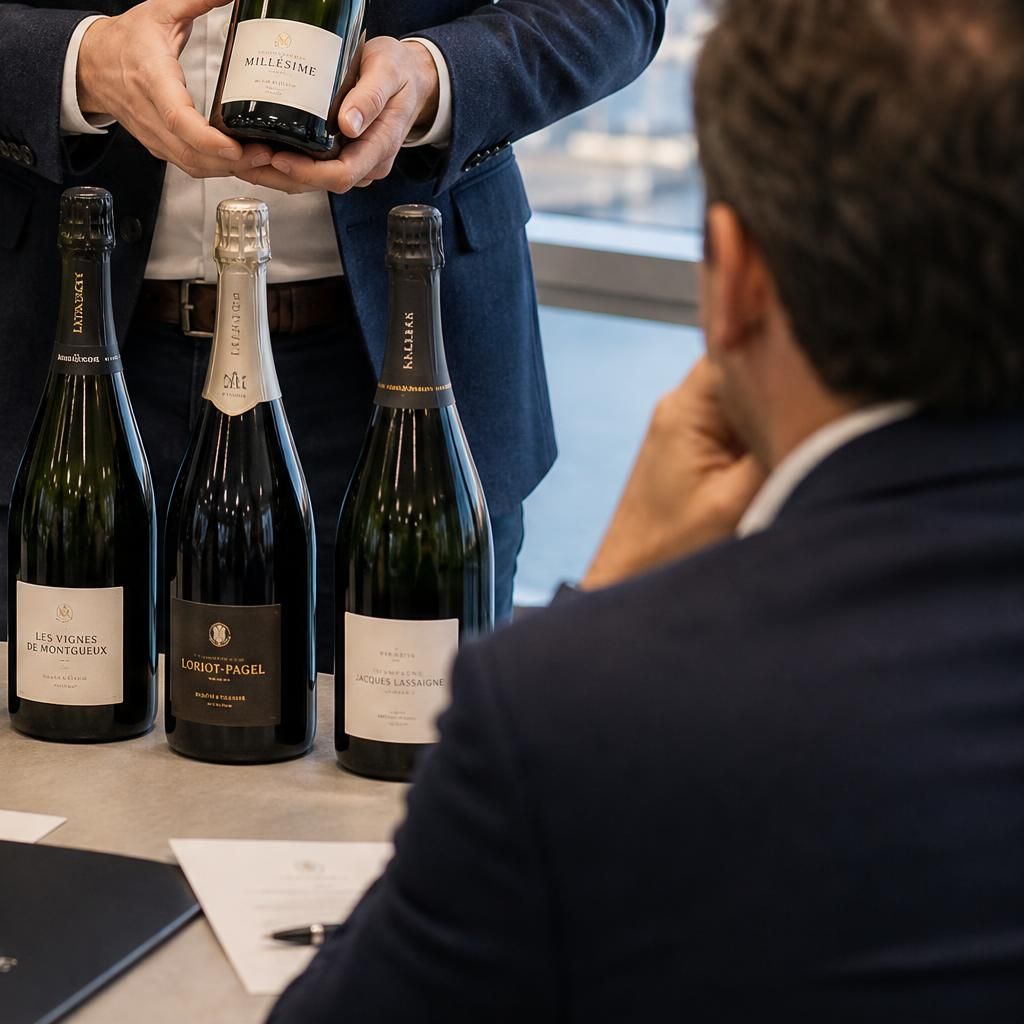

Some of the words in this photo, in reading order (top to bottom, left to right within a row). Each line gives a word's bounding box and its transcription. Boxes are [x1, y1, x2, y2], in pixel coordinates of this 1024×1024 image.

[245, 55, 317, 77] MILLÉSIME
[35, 632, 53, 643] LES
[56, 635, 98, 644] VIGNES
[27, 642, 38, 652] DE
[40, 645, 108, 656] MONTGUEUX
[181, 657, 266, 675] LORIOT-PAGEL
[355, 674, 392, 687] JACQUES
[393, 678, 445, 688] LASSAIGNE
